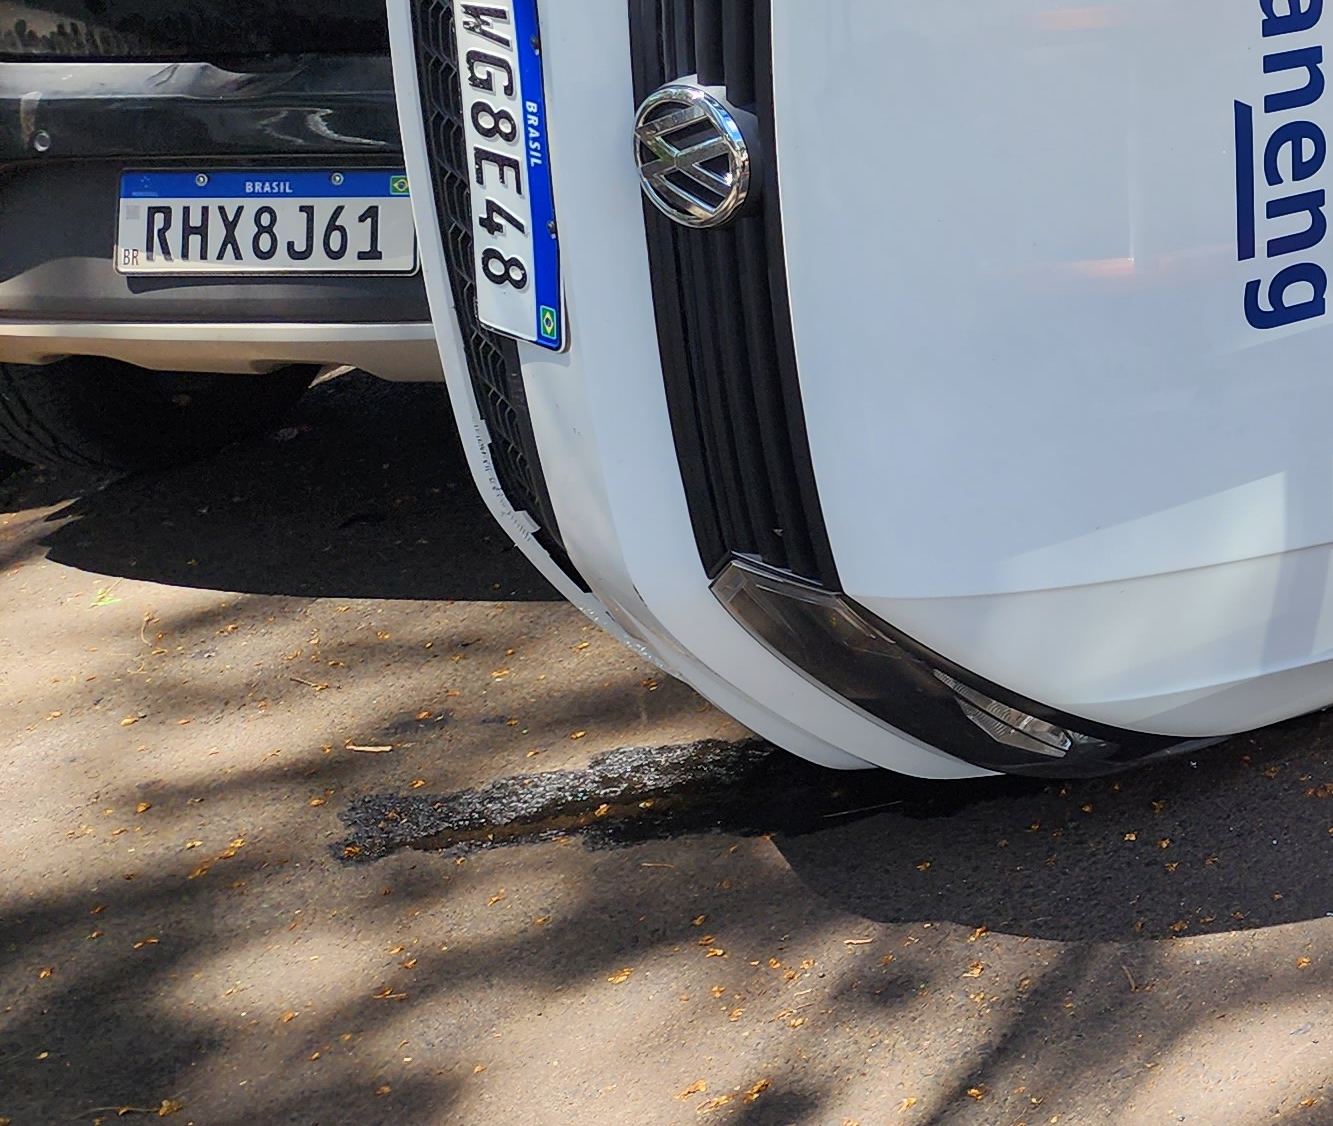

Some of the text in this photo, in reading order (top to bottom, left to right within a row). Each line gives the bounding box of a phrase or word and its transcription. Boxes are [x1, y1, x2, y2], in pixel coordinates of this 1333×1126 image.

[525, 100, 543, 168] BRASIL
[245, 180, 293, 194] BRASIL
[146, 205, 383, 261] RHX8J61
[122, 248, 139, 266] BR
